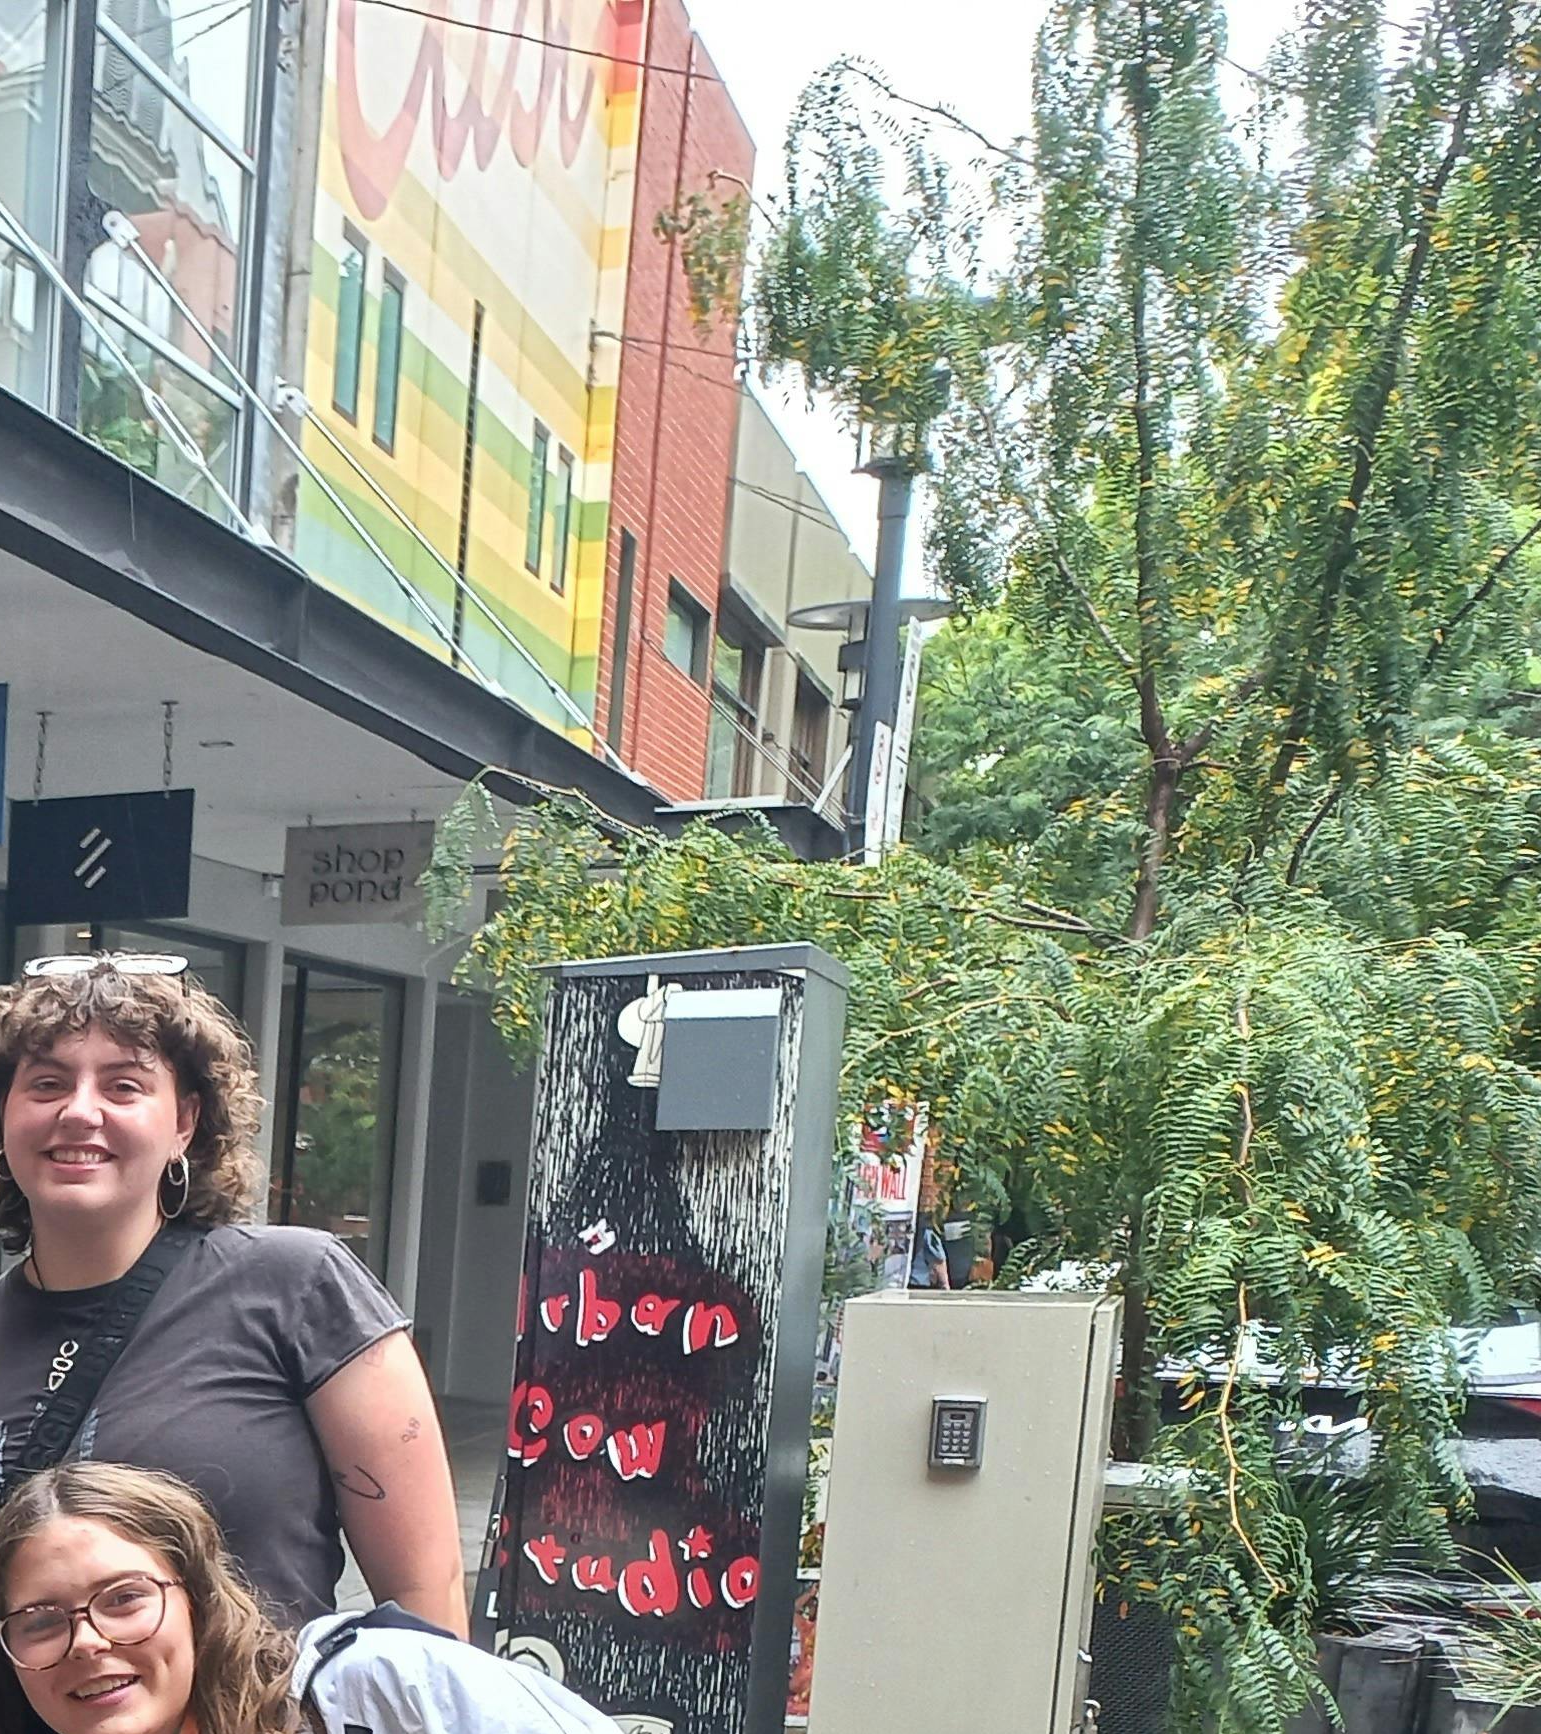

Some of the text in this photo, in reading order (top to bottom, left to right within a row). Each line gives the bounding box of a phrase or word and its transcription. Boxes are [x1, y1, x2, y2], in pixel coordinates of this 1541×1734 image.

[311, 843, 405, 875] shop
[308, 876, 403, 909] pond
[517, 1267, 740, 1356] rban
